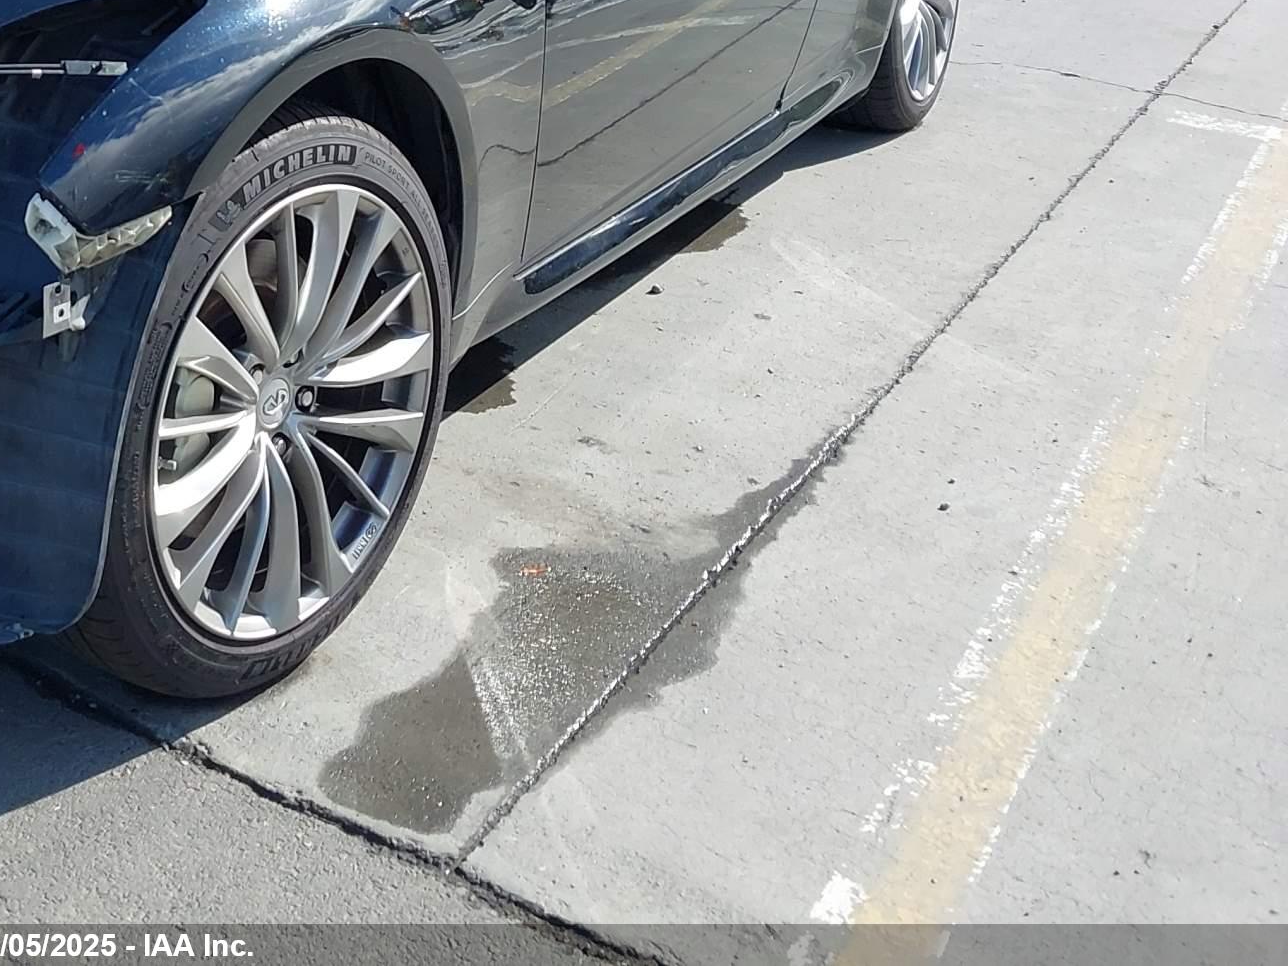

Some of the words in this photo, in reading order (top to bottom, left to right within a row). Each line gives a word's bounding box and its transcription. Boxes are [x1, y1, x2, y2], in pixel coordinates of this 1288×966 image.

[243, 144, 351, 203] MICHELIN
[364, 151, 386, 169] PILOT
[387, 165, 411, 189] SPORT
